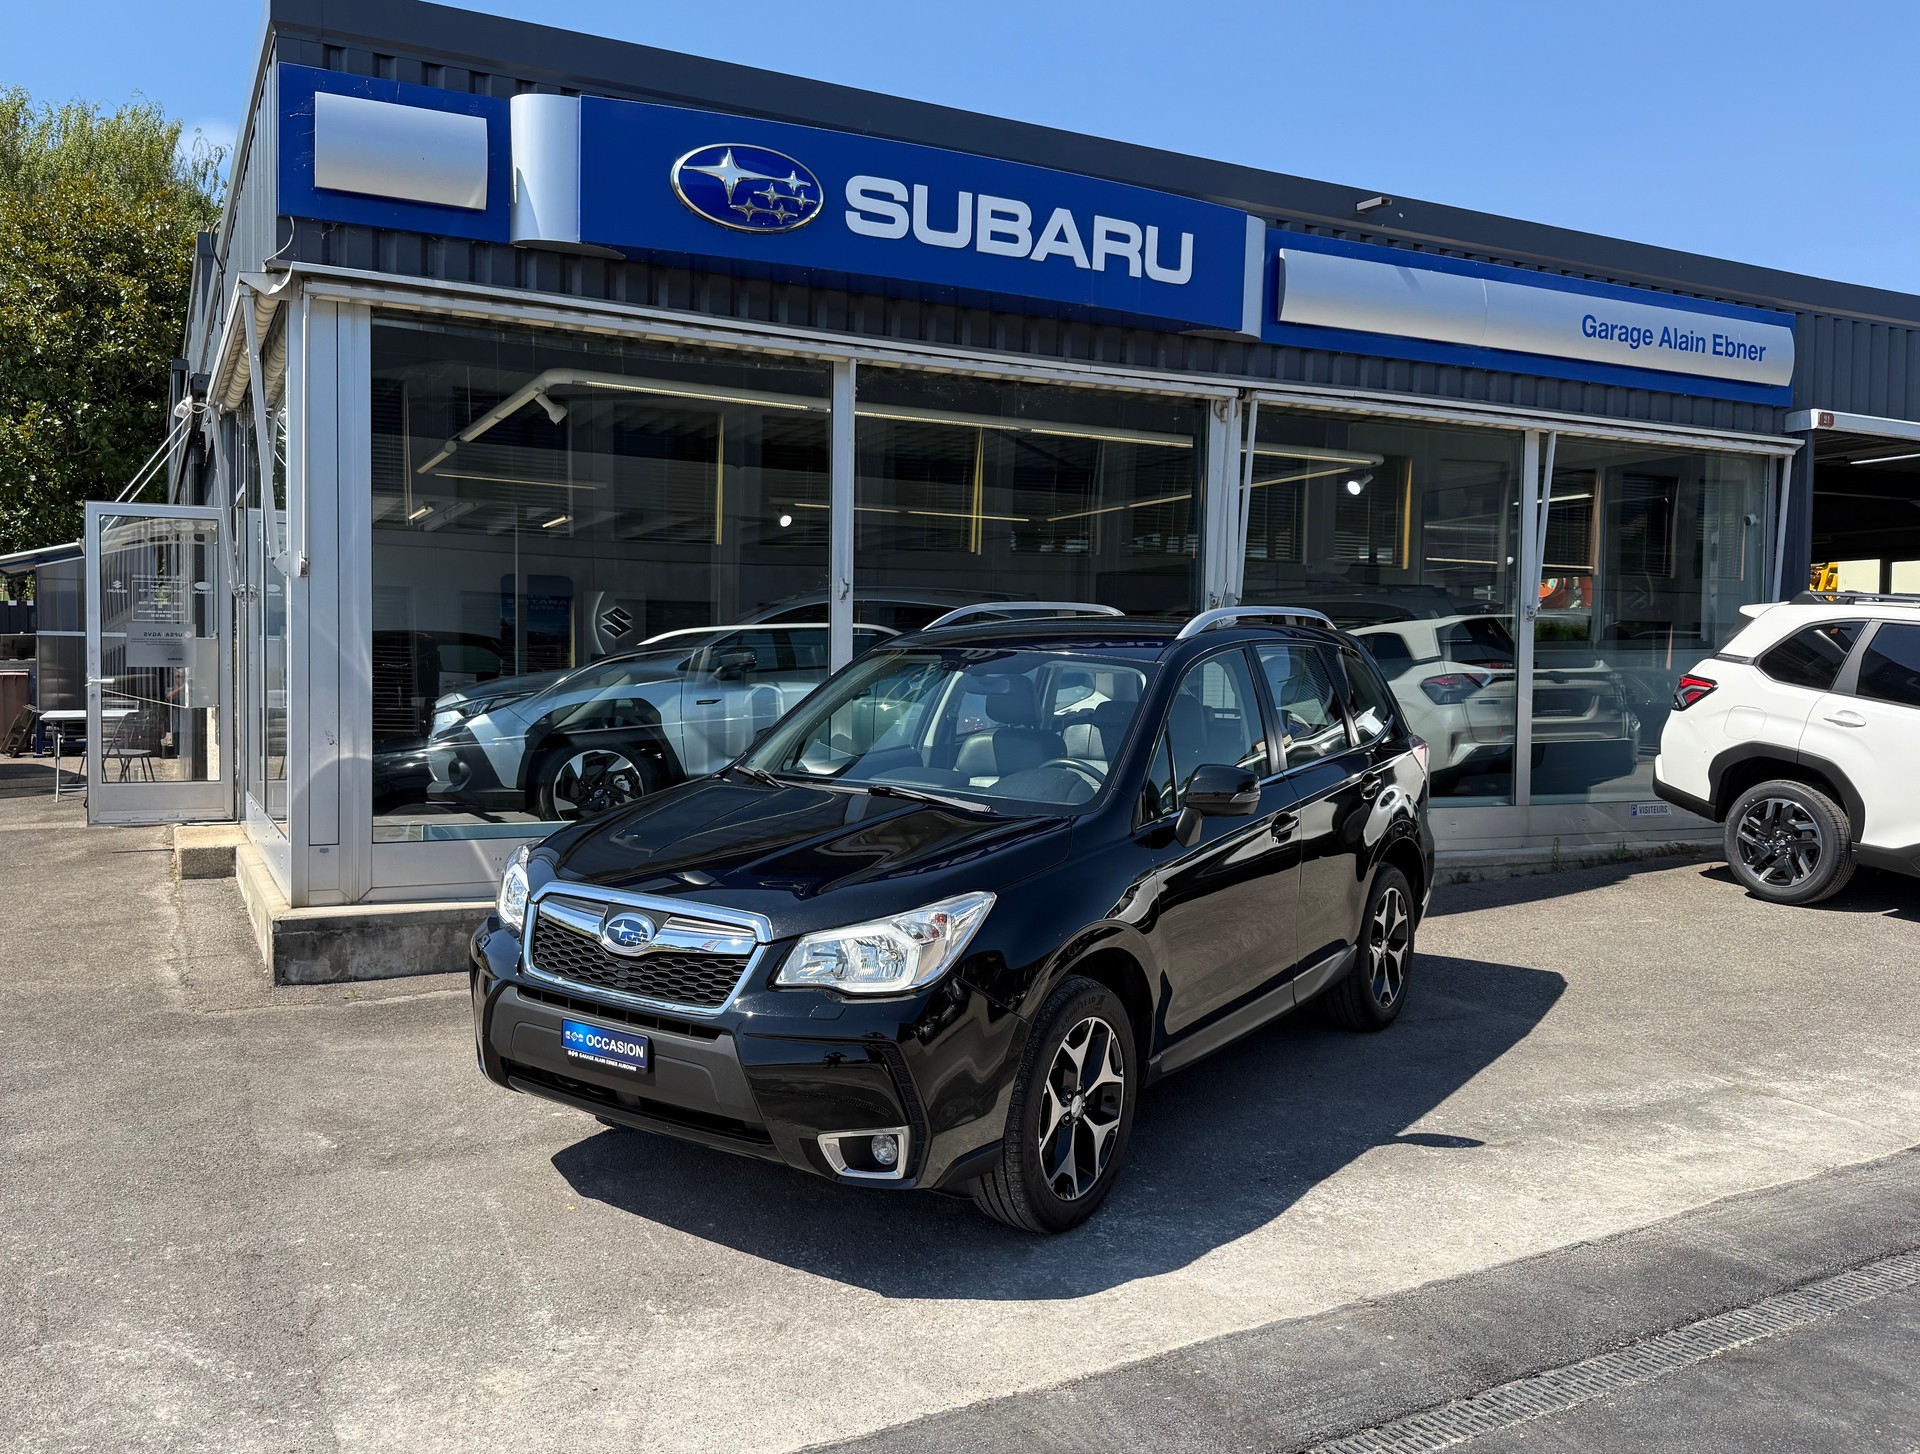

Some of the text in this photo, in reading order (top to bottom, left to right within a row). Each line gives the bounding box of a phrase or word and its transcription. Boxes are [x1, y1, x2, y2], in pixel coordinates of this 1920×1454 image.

[845, 174, 1194, 285] SUBARU
[1582, 314, 1767, 362] Garage Alain Ebner
[1639, 805, 1668, 814] VISITEURS
[586, 1034, 644, 1058] OCCASION
